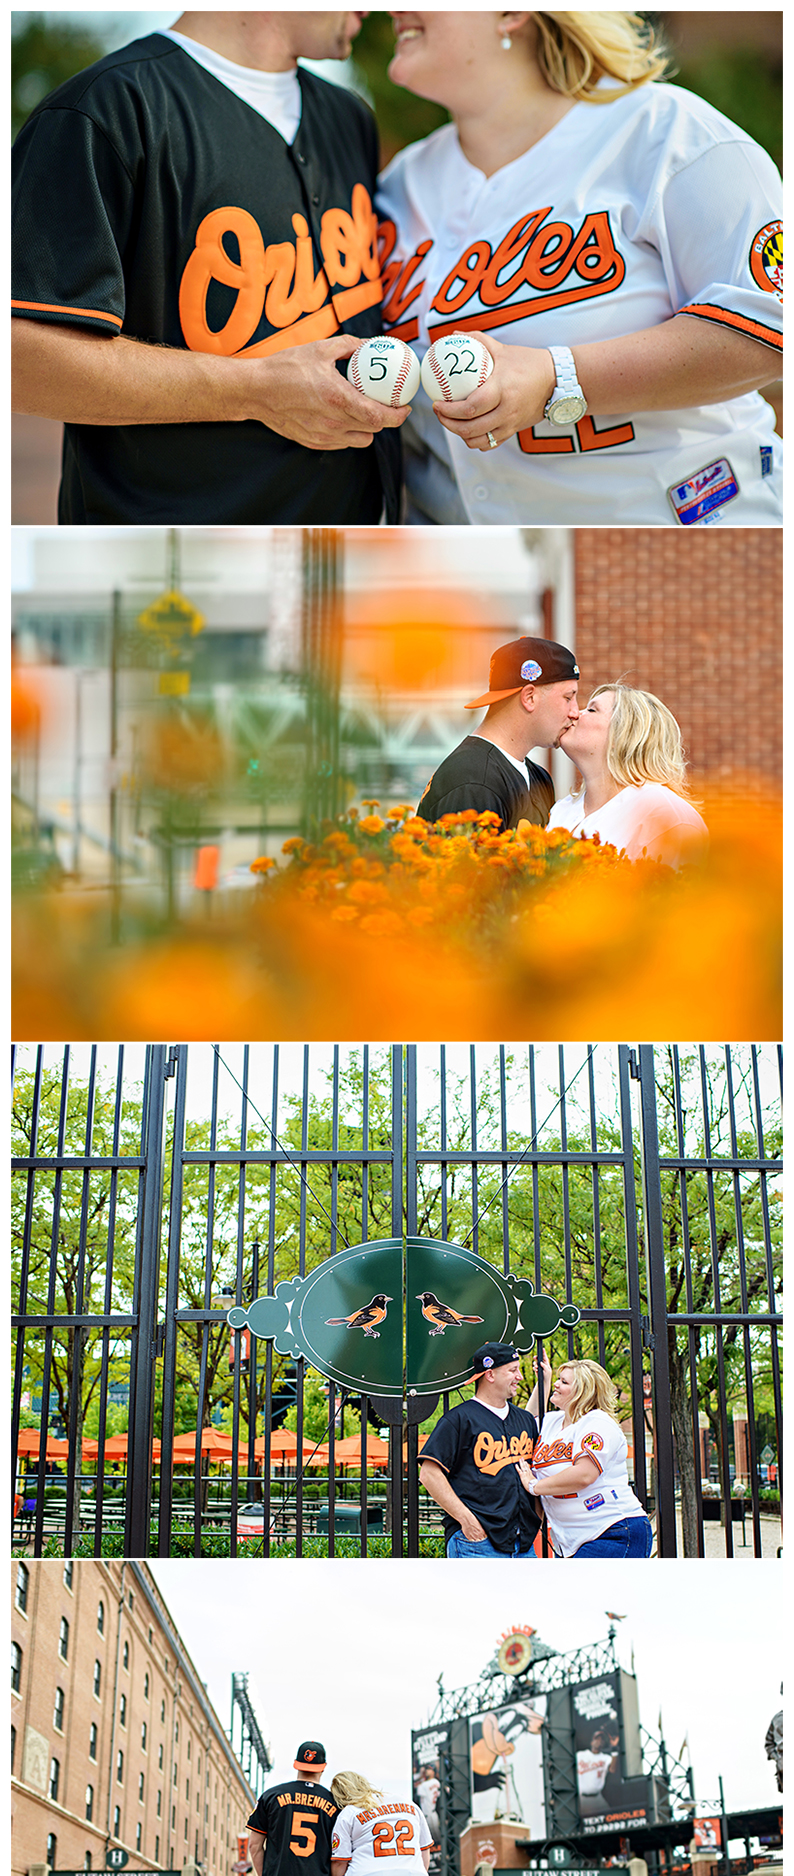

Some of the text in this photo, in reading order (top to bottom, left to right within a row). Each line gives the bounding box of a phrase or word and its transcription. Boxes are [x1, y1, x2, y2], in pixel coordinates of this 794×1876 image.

[369, 357, 388, 381] 5
[444, 349, 478, 377] 22
[606, 1809, 646, 1822] ORIOLES
[289, 1811, 319, 1857] 5
[371, 1819, 415, 1857] 22
